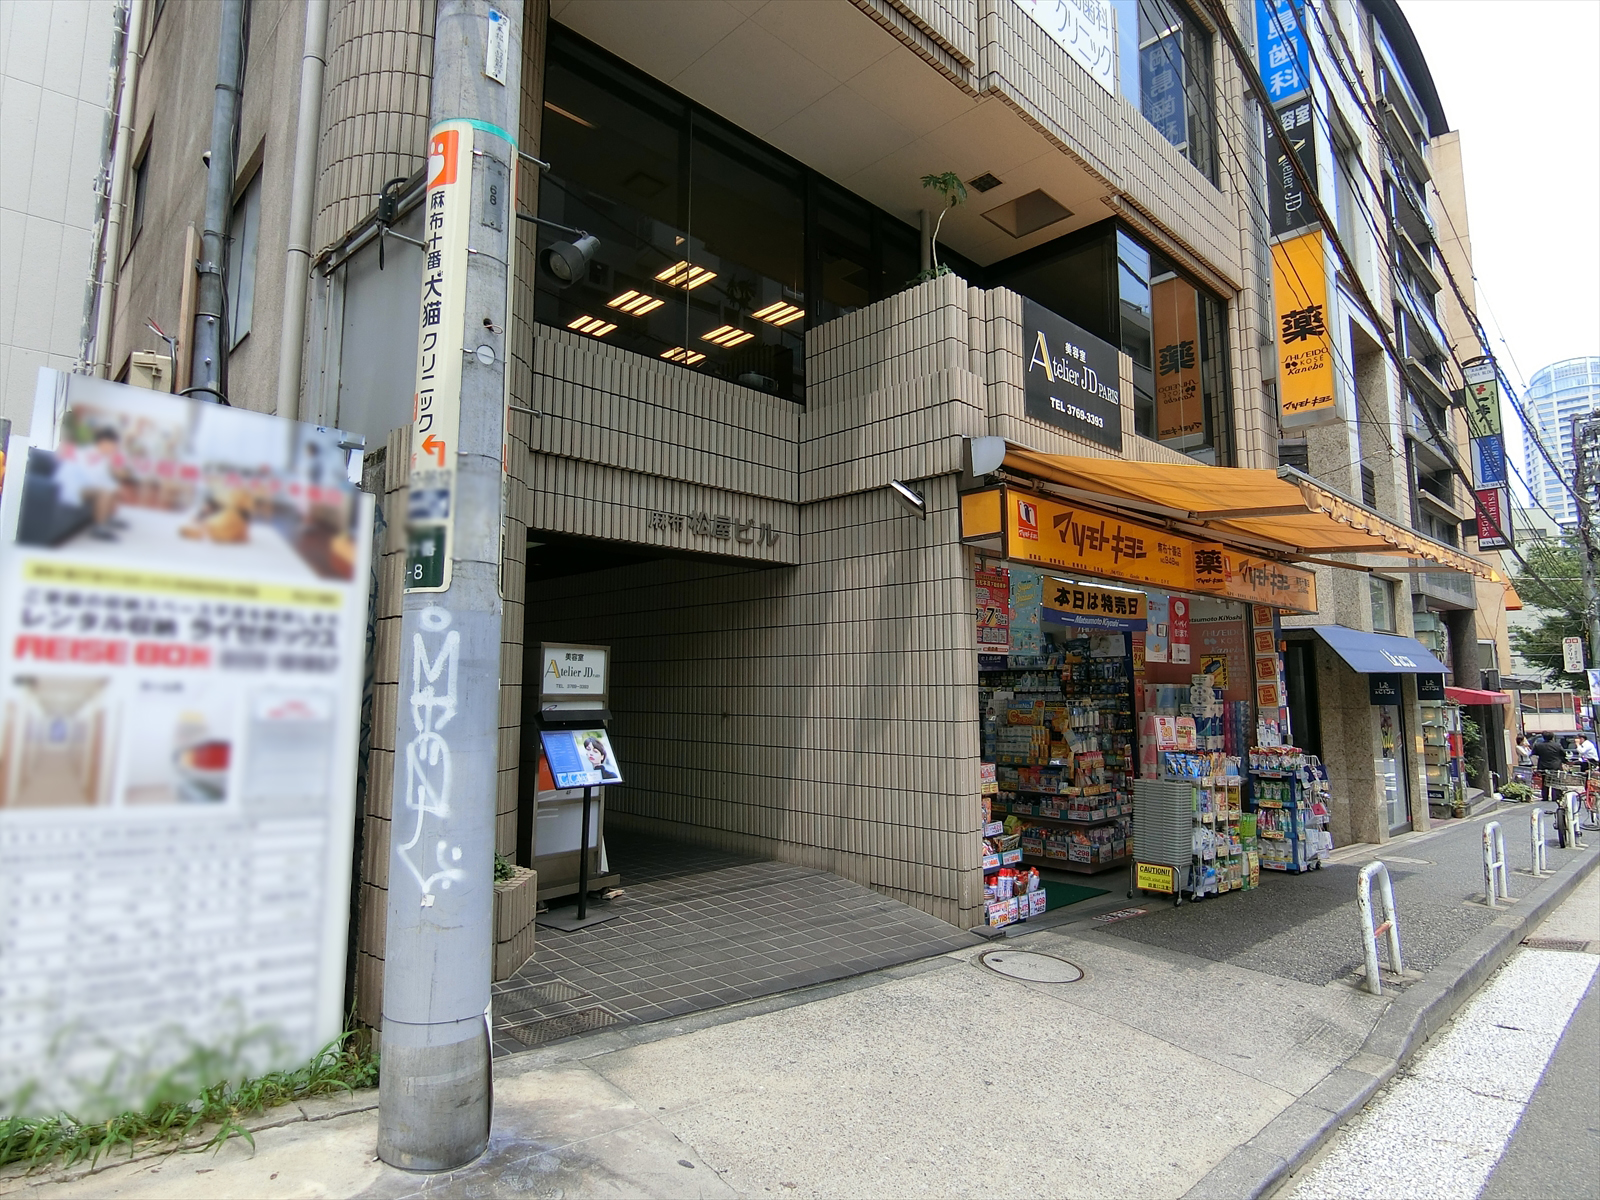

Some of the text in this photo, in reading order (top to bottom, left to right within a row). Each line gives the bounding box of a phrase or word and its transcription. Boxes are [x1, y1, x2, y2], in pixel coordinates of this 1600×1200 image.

[1267, 0, 1300, 96] 島歯科
[1281, 305, 1324, 345] 薬
[1065, 342, 1087, 363] 美容室
[1281, 347, 1329, 364] SHISEIDO
[1028, 330, 1119, 405] Atelier JD PARIS
[1287, 363, 1324, 376] Kanebo
[1050, 397, 1104, 428] TEL 3769-3393
[1283, 396, 1332, 411] マツモトキヨシ
[1053, 511, 1147, 564] マツモトキヨシ
[1194, 549, 1223, 575] 薬
[1239, 559, 1290, 595] マツモトキヨシ
[1054, 586, 1138, 615] 本日は特売日
[545, 659, 593, 678] Atelier JD
[565, 653, 584, 661] 美容室
